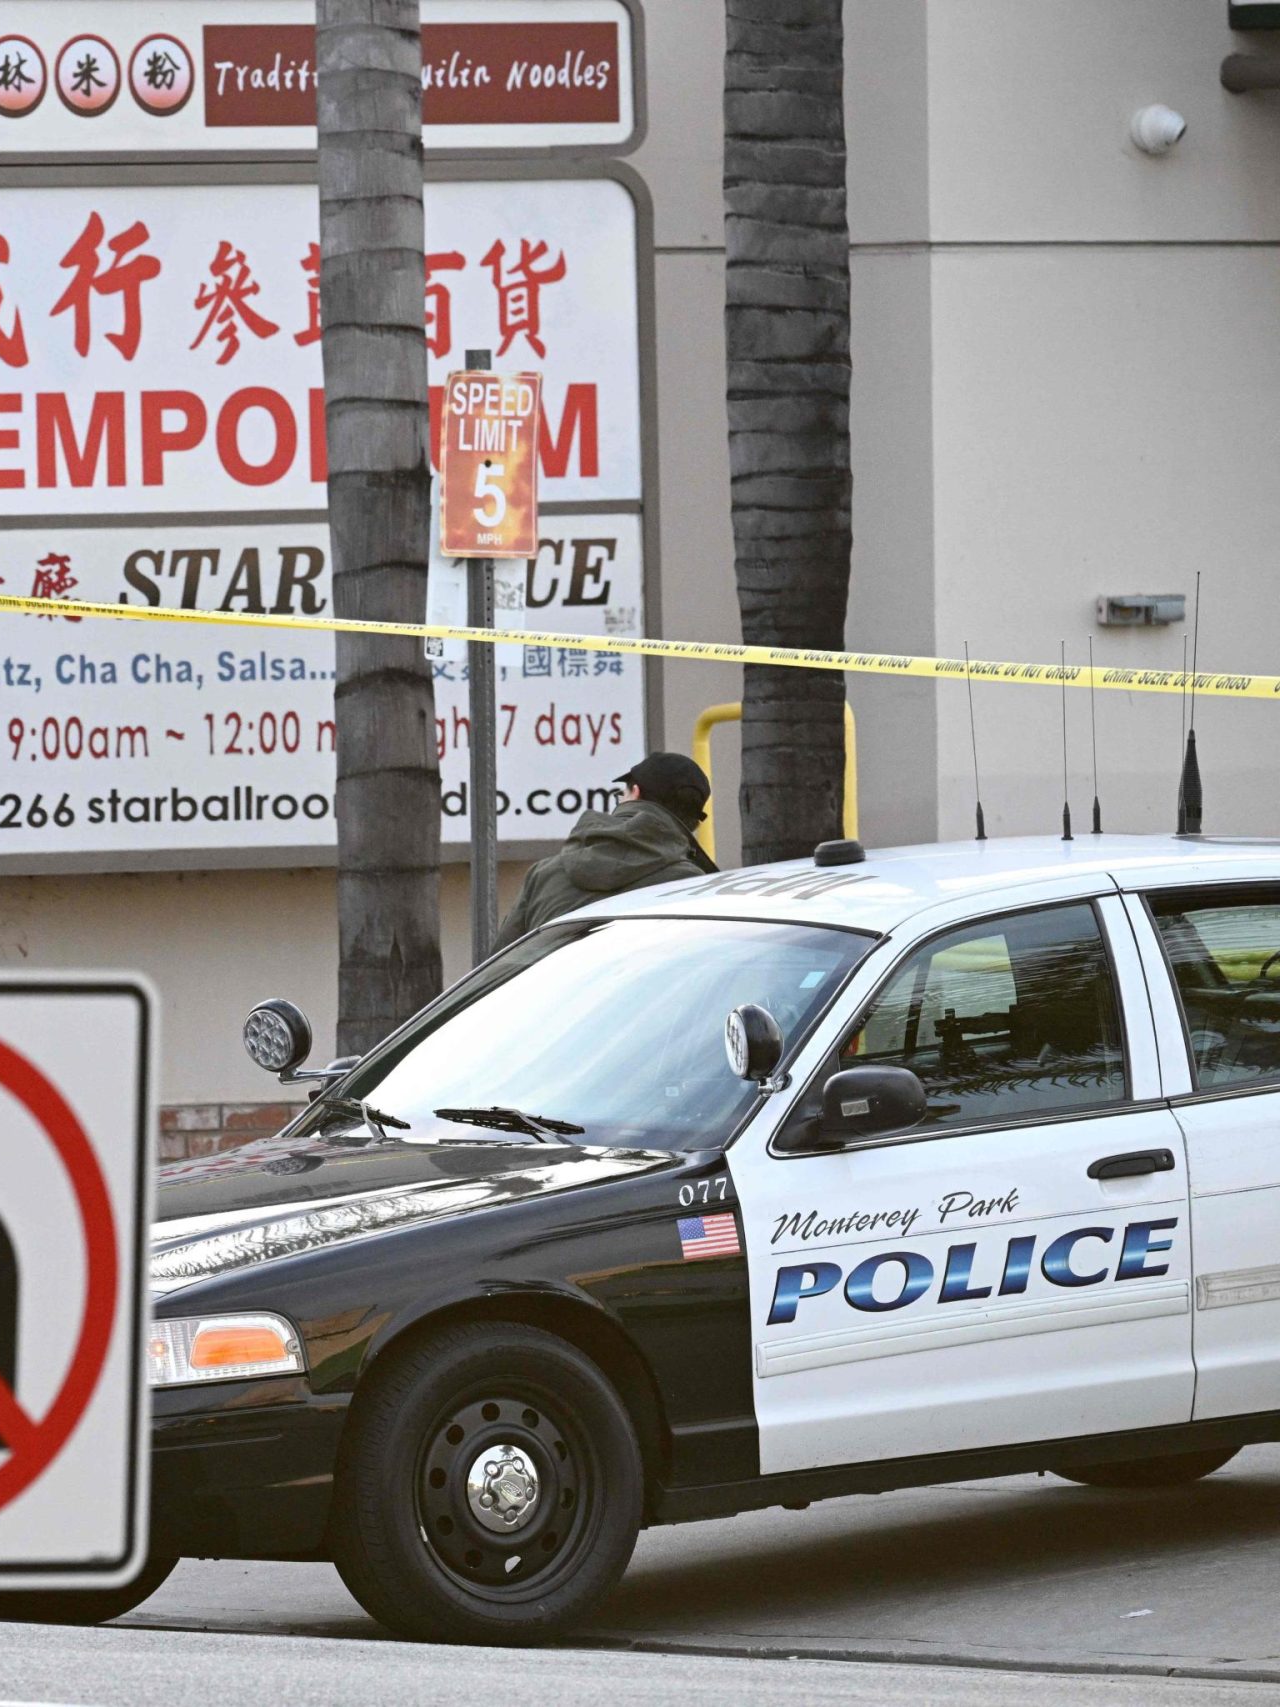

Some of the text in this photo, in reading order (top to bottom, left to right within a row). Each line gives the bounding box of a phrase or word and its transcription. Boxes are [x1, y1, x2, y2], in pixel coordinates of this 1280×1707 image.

[420, 50, 491, 89] uilin
[506, 49, 611, 90] Noodles
[451, 382, 534, 417] SPEED
[458, 418, 524, 452] LIMIT
[473, 462, 507, 528] 5
[477, 532, 503, 546] MPH
[118, 545, 327, 621] STAR
[55, 654, 118, 685] Cha
[130, 652, 204, 689] Cha,
[8, 716, 149, 762] 9:00am
[203, 710, 301, 756] 12:00
[500, 704, 519, 748] 7
[533, 702, 623, 756] days
[678, 1176, 728, 1208] 077
[771, 1187, 1021, 1246] Monterey Park
[765, 1216, 1179, 1326] POLICE
